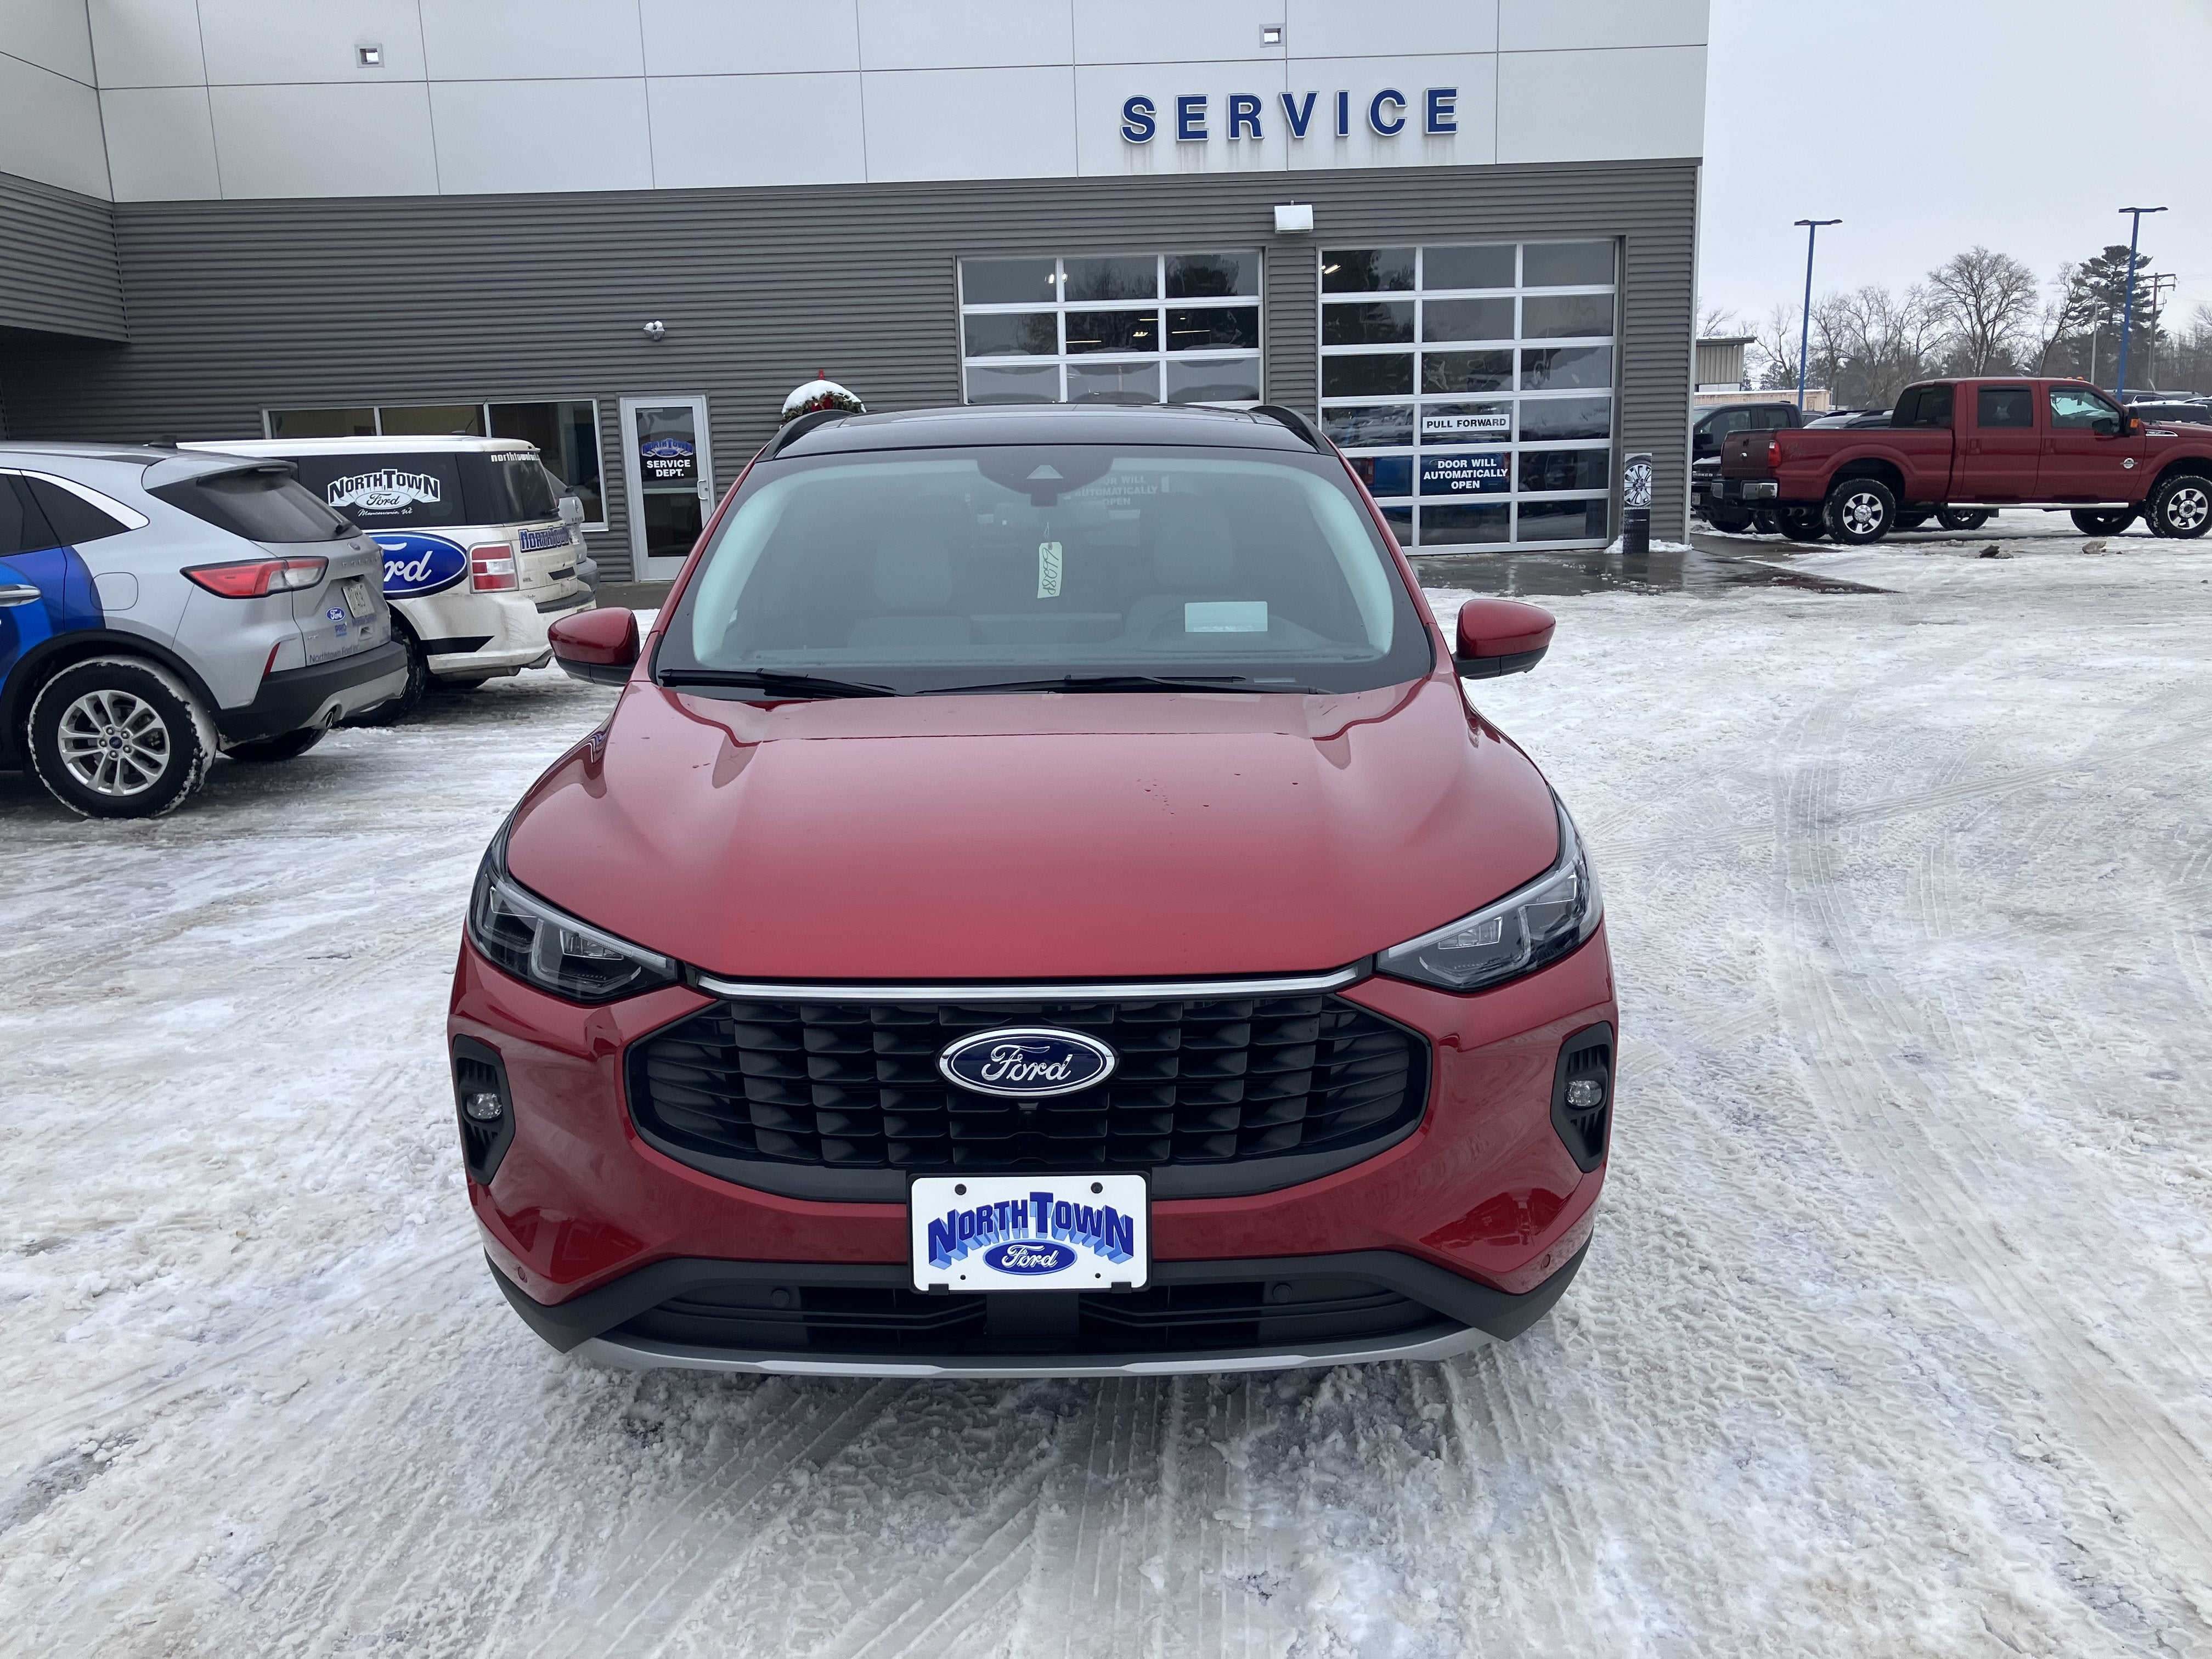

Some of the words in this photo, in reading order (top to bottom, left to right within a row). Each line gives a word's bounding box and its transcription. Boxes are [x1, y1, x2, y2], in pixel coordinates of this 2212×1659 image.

[1120, 87, 1458, 143] SERVICE
[1426, 420, 1453, 428] PULL
[1457, 418, 1506, 427] FORWARD
[646, 459, 691, 468] SERVICE
[1437, 460, 1468, 469] DOOR
[1471, 458, 1497, 467] WILL
[656, 469, 684, 477] DEPT.
[1424, 469, 1508, 480] AUTOMATICALLY
[1121, 476, 1146, 484] WILL
[1451, 480, 1480, 489] OPEN
[366, 493, 400, 505] Ford
[981, 1044, 1073, 1081] Ford
[1001, 1244, 1059, 1268] Ford
